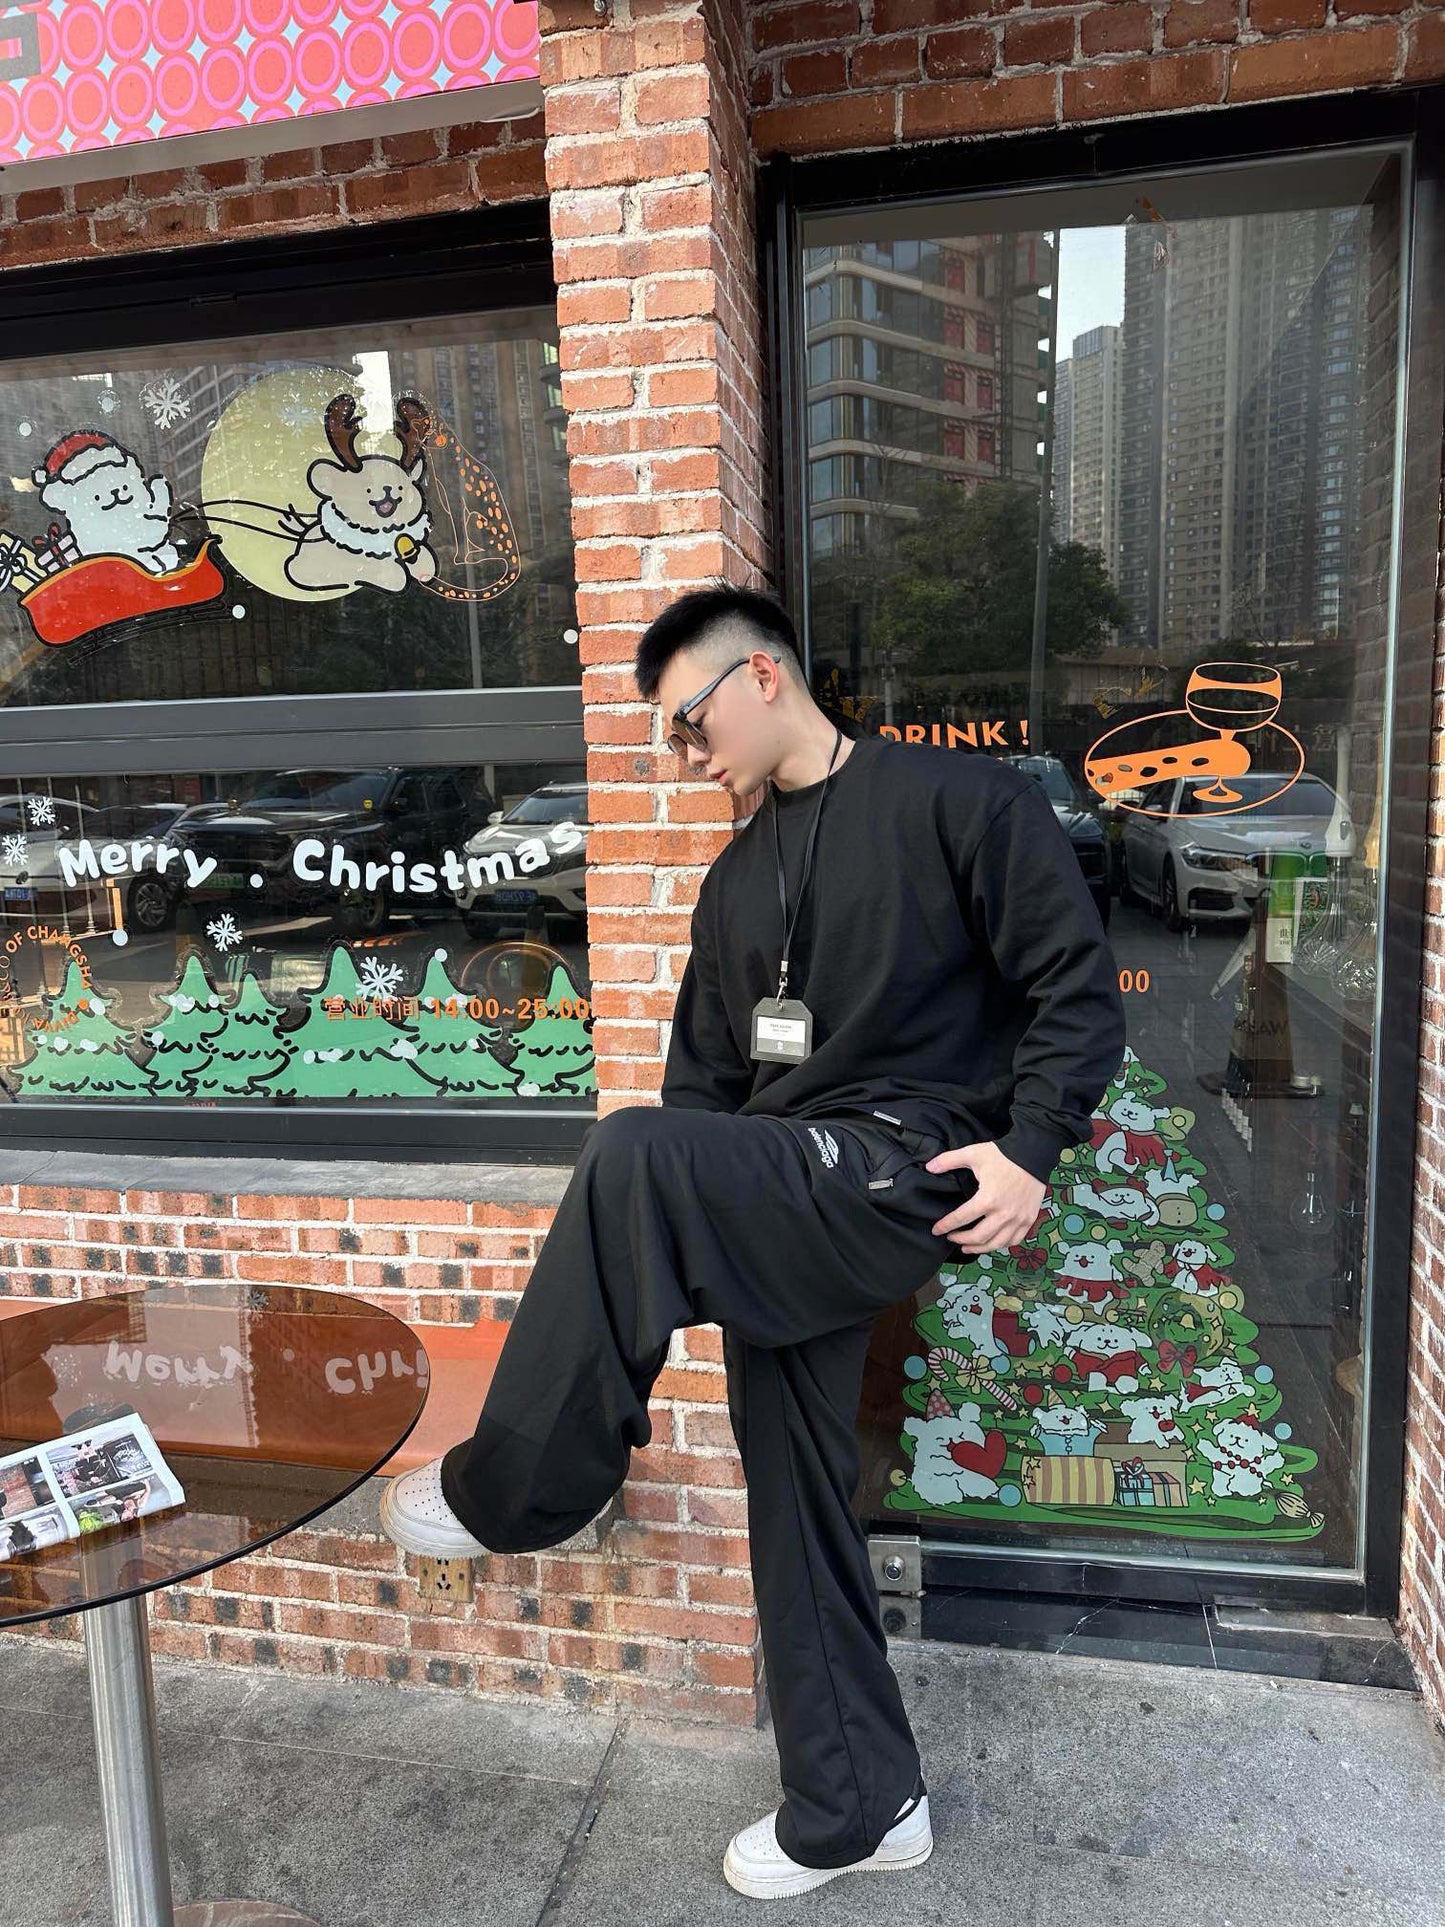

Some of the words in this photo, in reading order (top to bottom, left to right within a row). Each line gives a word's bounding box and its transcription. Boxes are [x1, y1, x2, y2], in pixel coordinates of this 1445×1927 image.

[58, 838, 218, 888] Merry
[292, 821, 583, 893] Christmas
[5, 931, 23, 954] OF
[323, 995, 419, 1021] 营业时间
[807, 1127, 835, 1169] balenciaga
